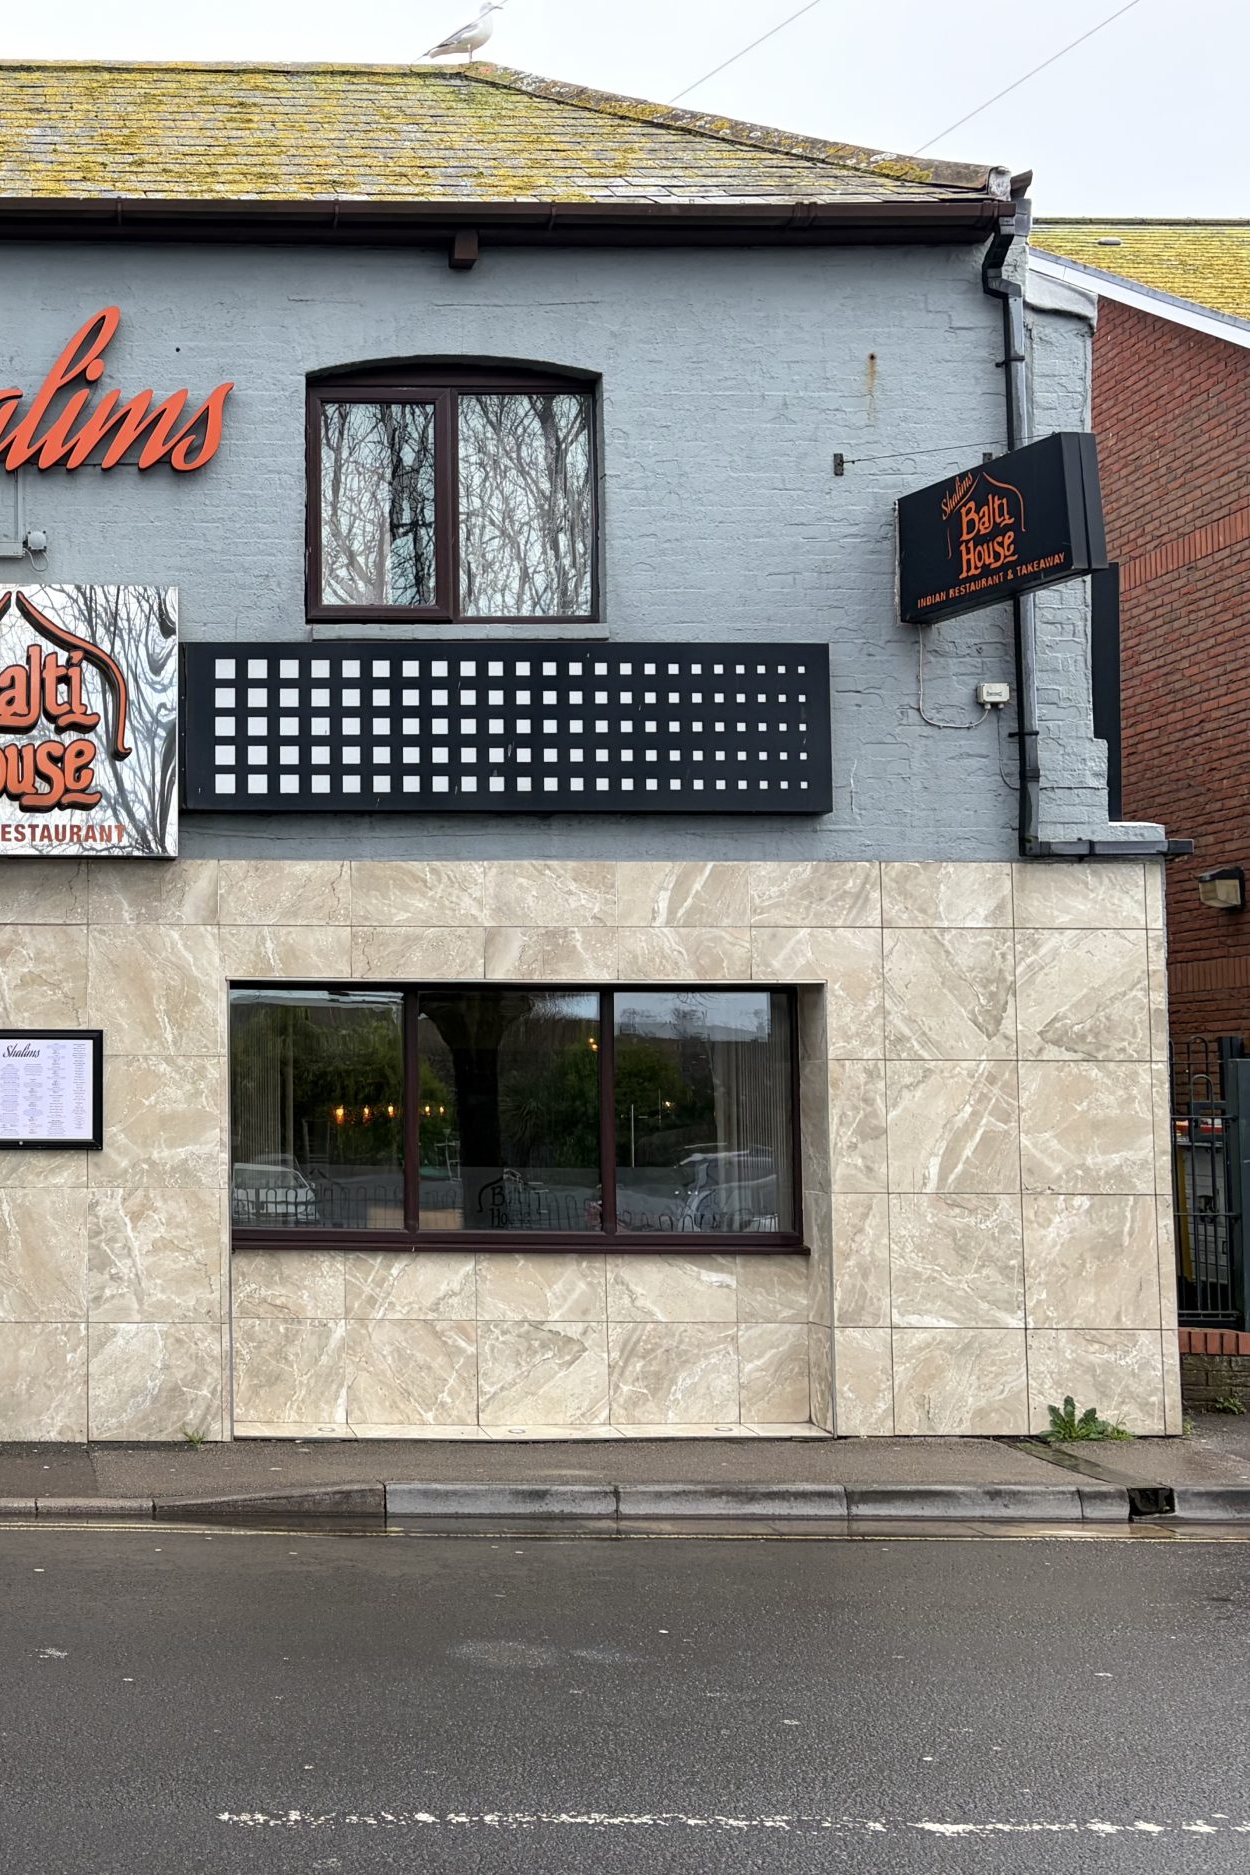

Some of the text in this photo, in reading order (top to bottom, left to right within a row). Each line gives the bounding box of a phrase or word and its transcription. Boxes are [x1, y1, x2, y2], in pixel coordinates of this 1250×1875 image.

[941, 471, 973, 520] Shalims
[960, 494, 1015, 541] Balti
[959, 531, 1018, 579] House
[917, 551, 1065, 609] INDIAN RESTAURANT & TAKEAWAY
[2, 1042, 41, 1058] Shalims
